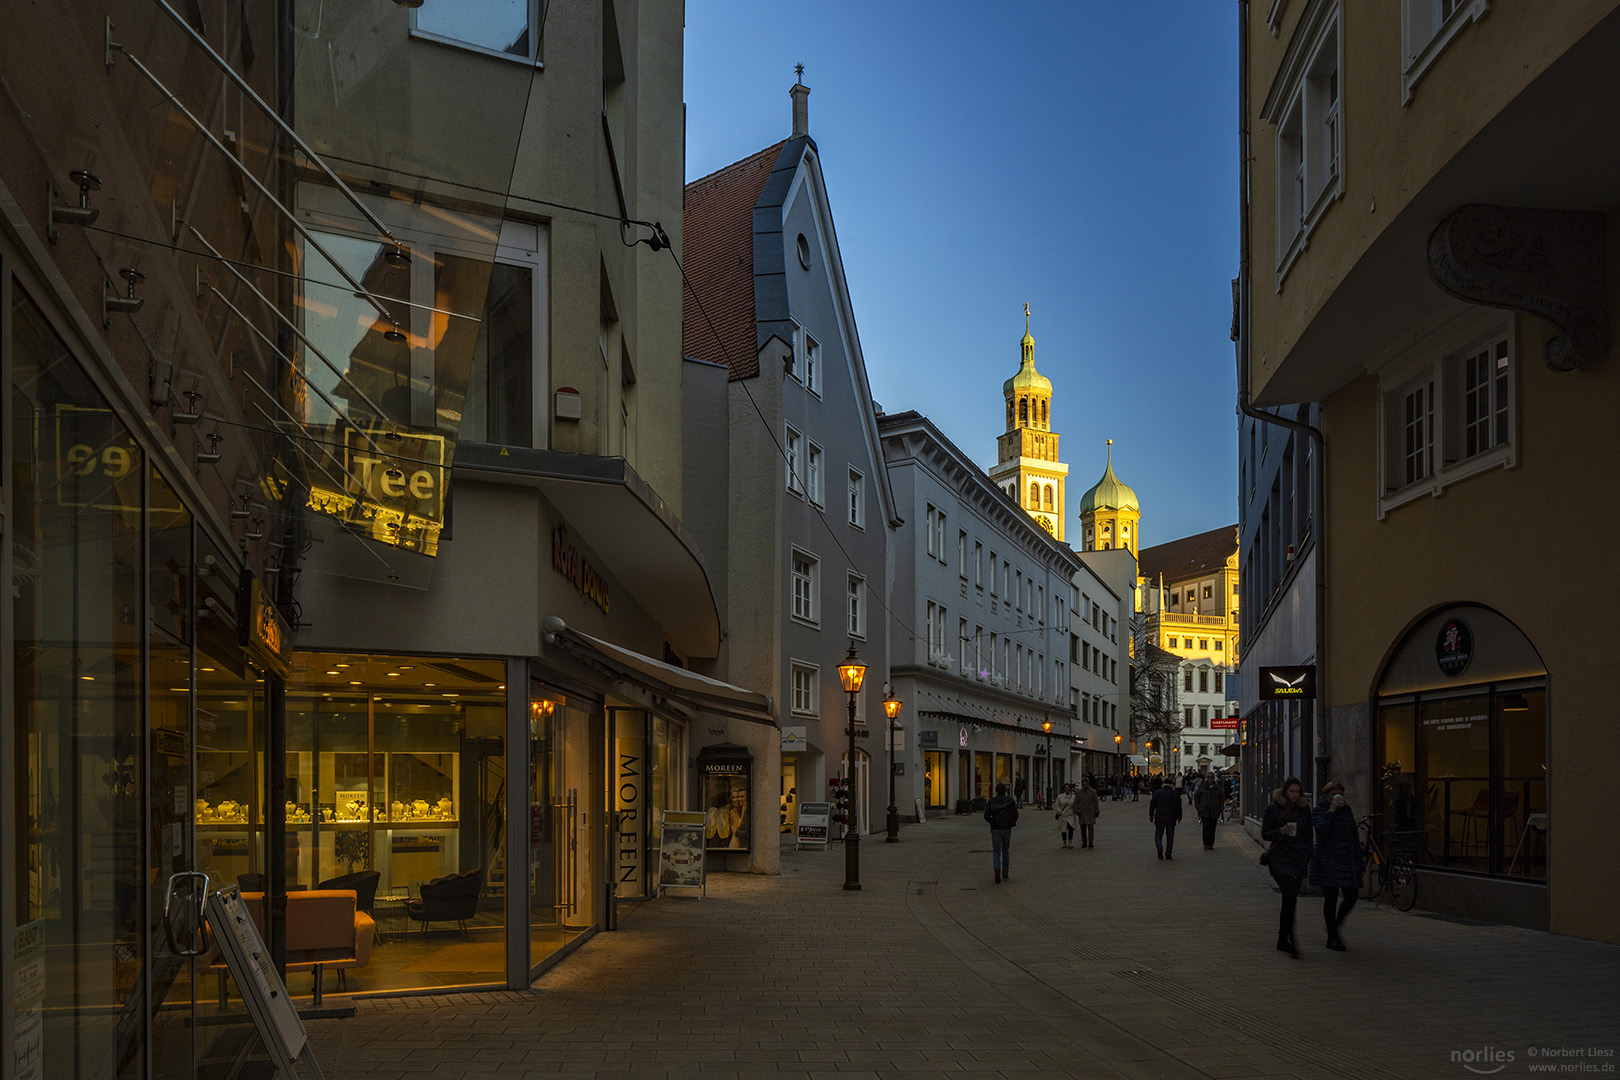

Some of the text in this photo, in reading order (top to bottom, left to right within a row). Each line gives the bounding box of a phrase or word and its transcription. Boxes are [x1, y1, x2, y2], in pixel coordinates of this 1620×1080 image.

[353, 456, 434, 499] Tee
[552, 527, 610, 615] ROYAL DONUTS
[620, 752, 640, 883] MOREEN
